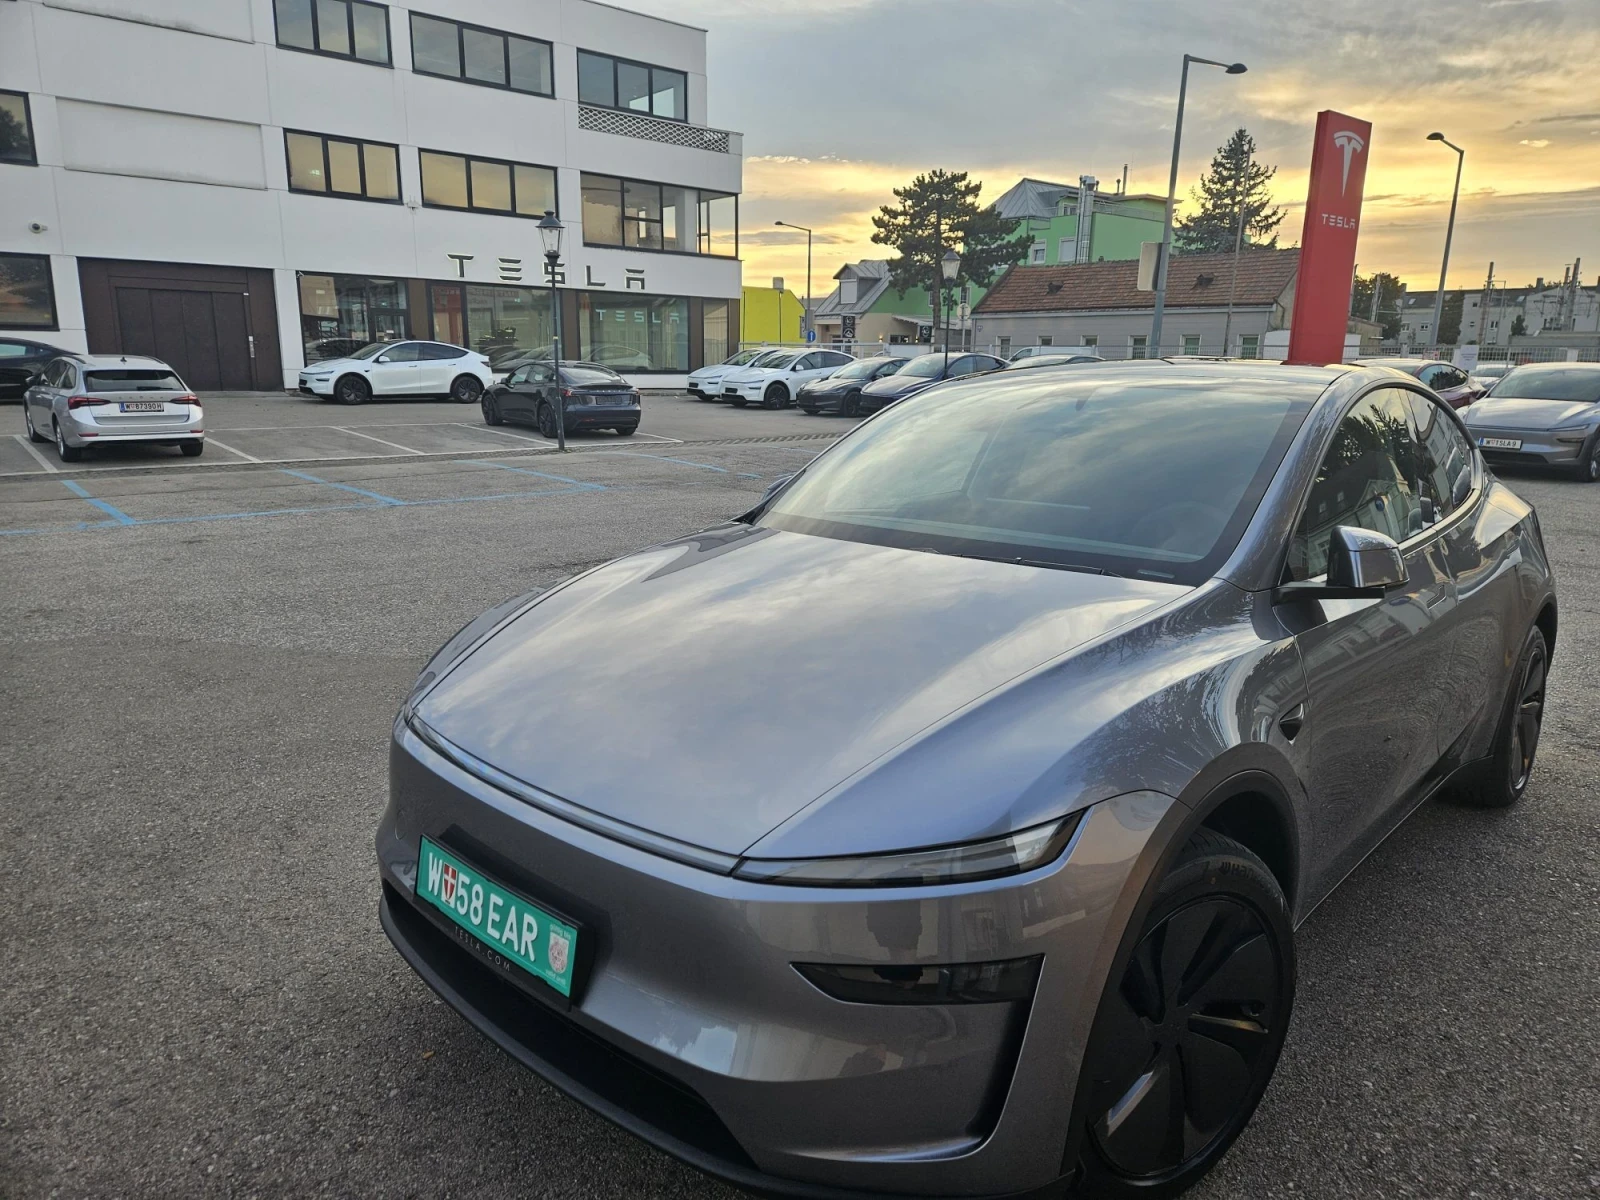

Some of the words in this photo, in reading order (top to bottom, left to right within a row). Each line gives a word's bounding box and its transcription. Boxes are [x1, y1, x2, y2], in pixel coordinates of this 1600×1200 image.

[1322, 213, 1356, 229] TESLA
[447, 253, 645, 290] TESLA
[595, 308, 680, 324] TESLA
[428, 852, 443, 896] W
[456, 872, 484, 926] 58
[487, 892, 538, 962] EAR
[455, 926, 511, 972] TESLA.COM
